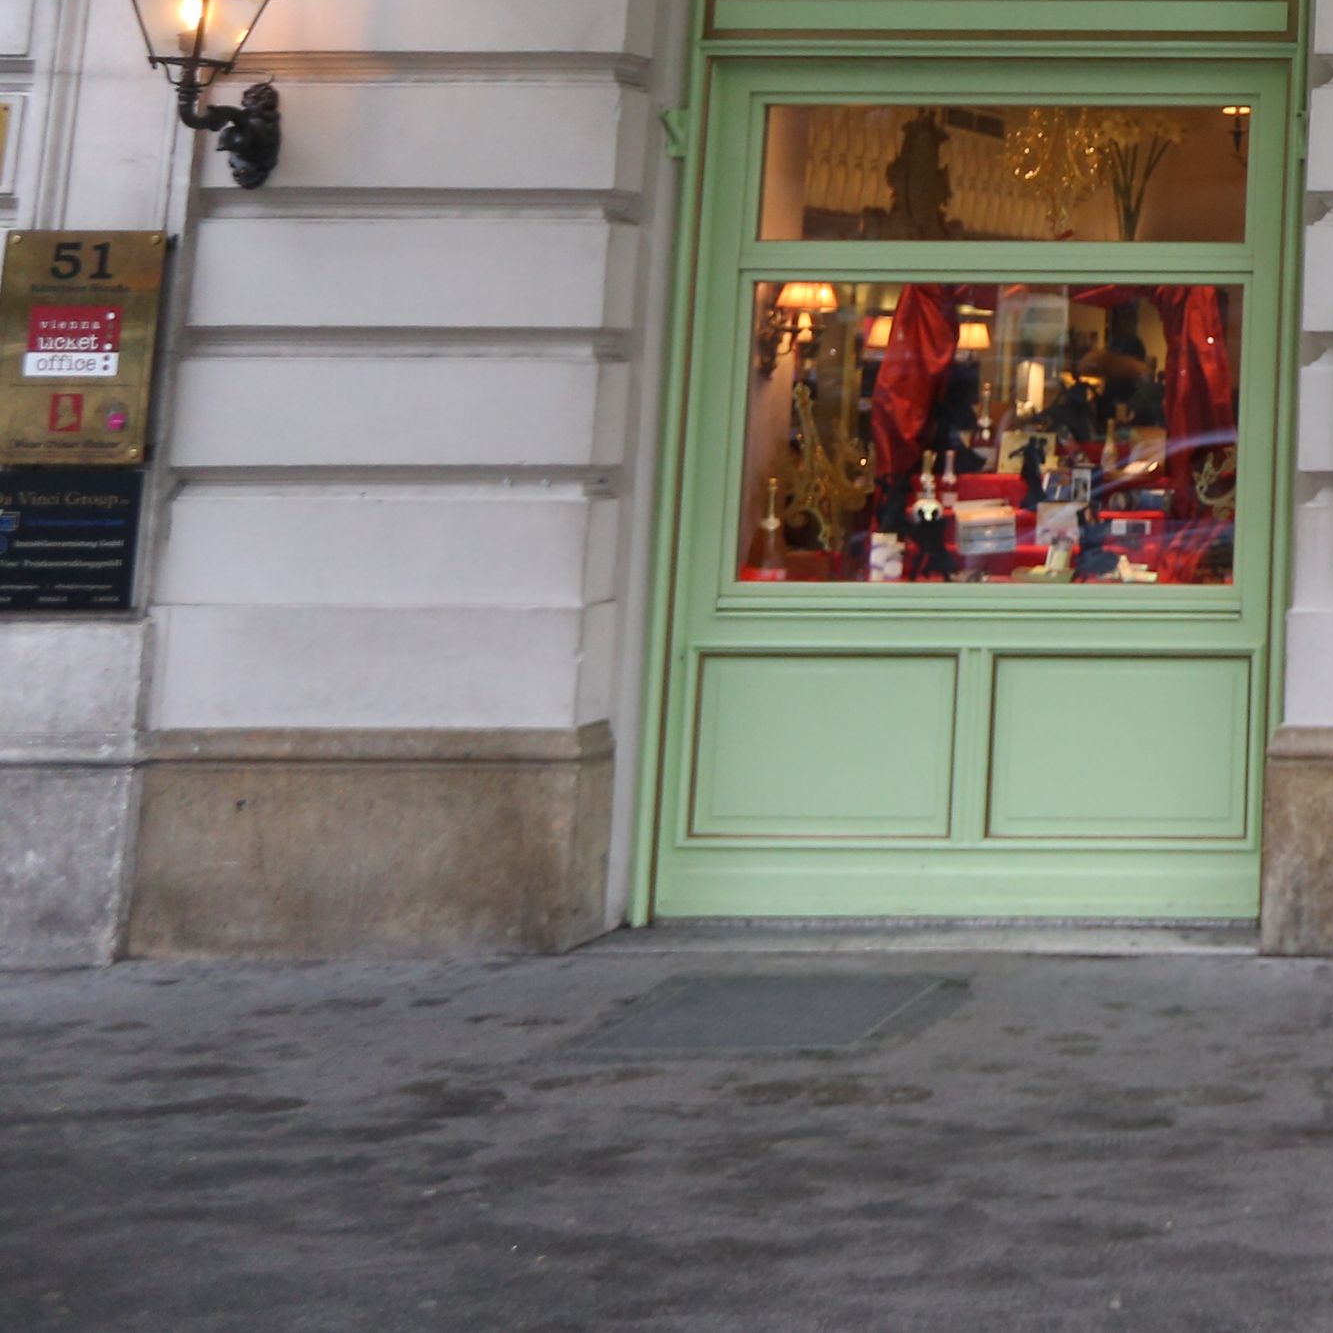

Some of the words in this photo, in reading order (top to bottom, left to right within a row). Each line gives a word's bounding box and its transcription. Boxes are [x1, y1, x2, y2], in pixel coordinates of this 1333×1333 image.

[51, 241, 113, 280] 51
[40, 319, 101, 330] vienna
[36, 353, 97, 372] office
